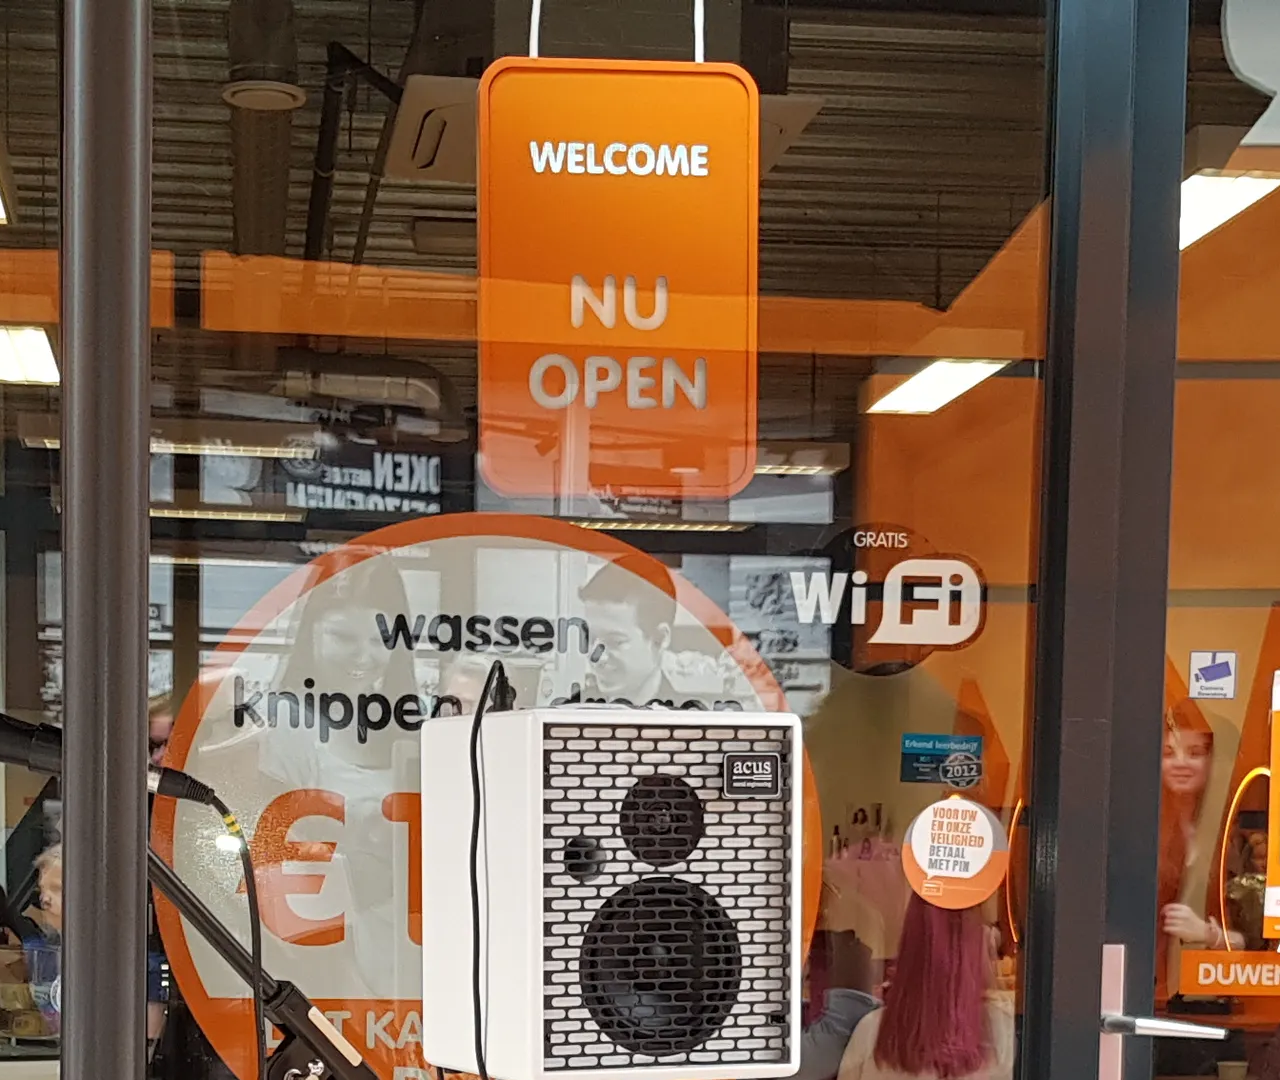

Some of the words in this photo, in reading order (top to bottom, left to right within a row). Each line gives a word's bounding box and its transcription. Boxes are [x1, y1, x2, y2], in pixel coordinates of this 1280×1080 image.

[528, 140, 709, 177] WELCOME
[570, 273, 668, 330] NU
[528, 353, 707, 410] OPEN
[853, 531, 908, 548] GRATIS
[375, 612, 606, 664] wassen,
[732, 760, 772, 774] acus
[946, 765, 978, 778] 2012
[932, 807, 959, 820] VOOR
[961, 809, 978, 821] UW
[931, 820, 944, 832] EN
[946, 821, 972, 834] ONZE
[930, 832, 985, 848] VEILIGHEID
[929, 845, 966, 859] BETAAL
[927, 858, 951, 871] MET
[952, 860, 970, 873] PIN
